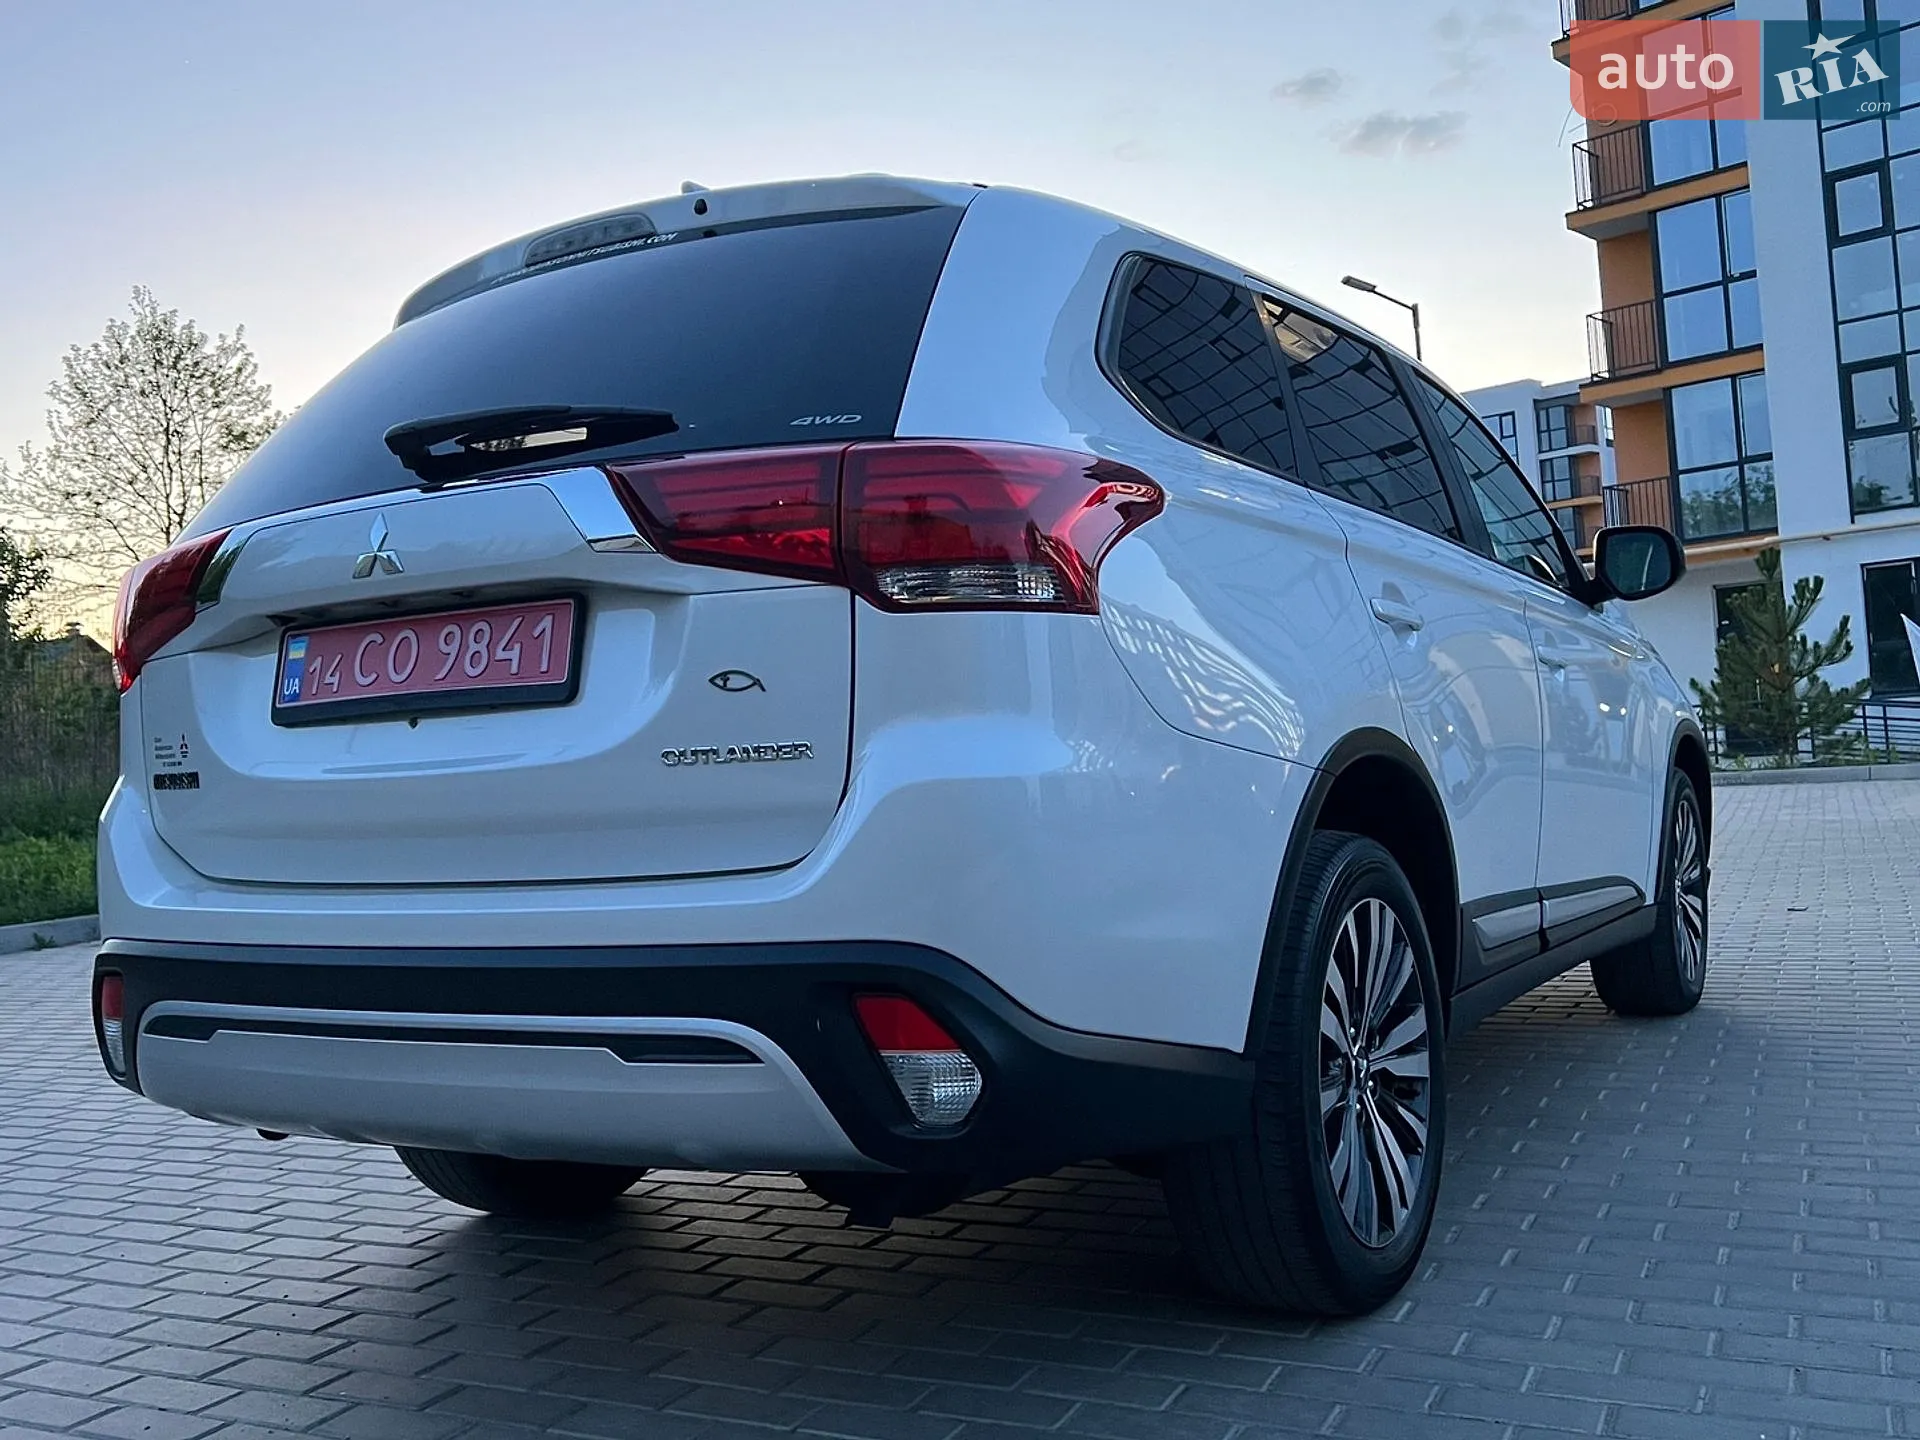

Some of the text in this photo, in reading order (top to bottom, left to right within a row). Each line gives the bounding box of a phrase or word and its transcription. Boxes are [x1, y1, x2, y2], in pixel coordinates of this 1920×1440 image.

[789, 414, 862, 426] 4WD
[308, 653, 343, 697] 14
[433, 612, 556, 682] 9841
[283, 677, 300, 696] UA
[660, 740, 815, 768] OUTLANDER
